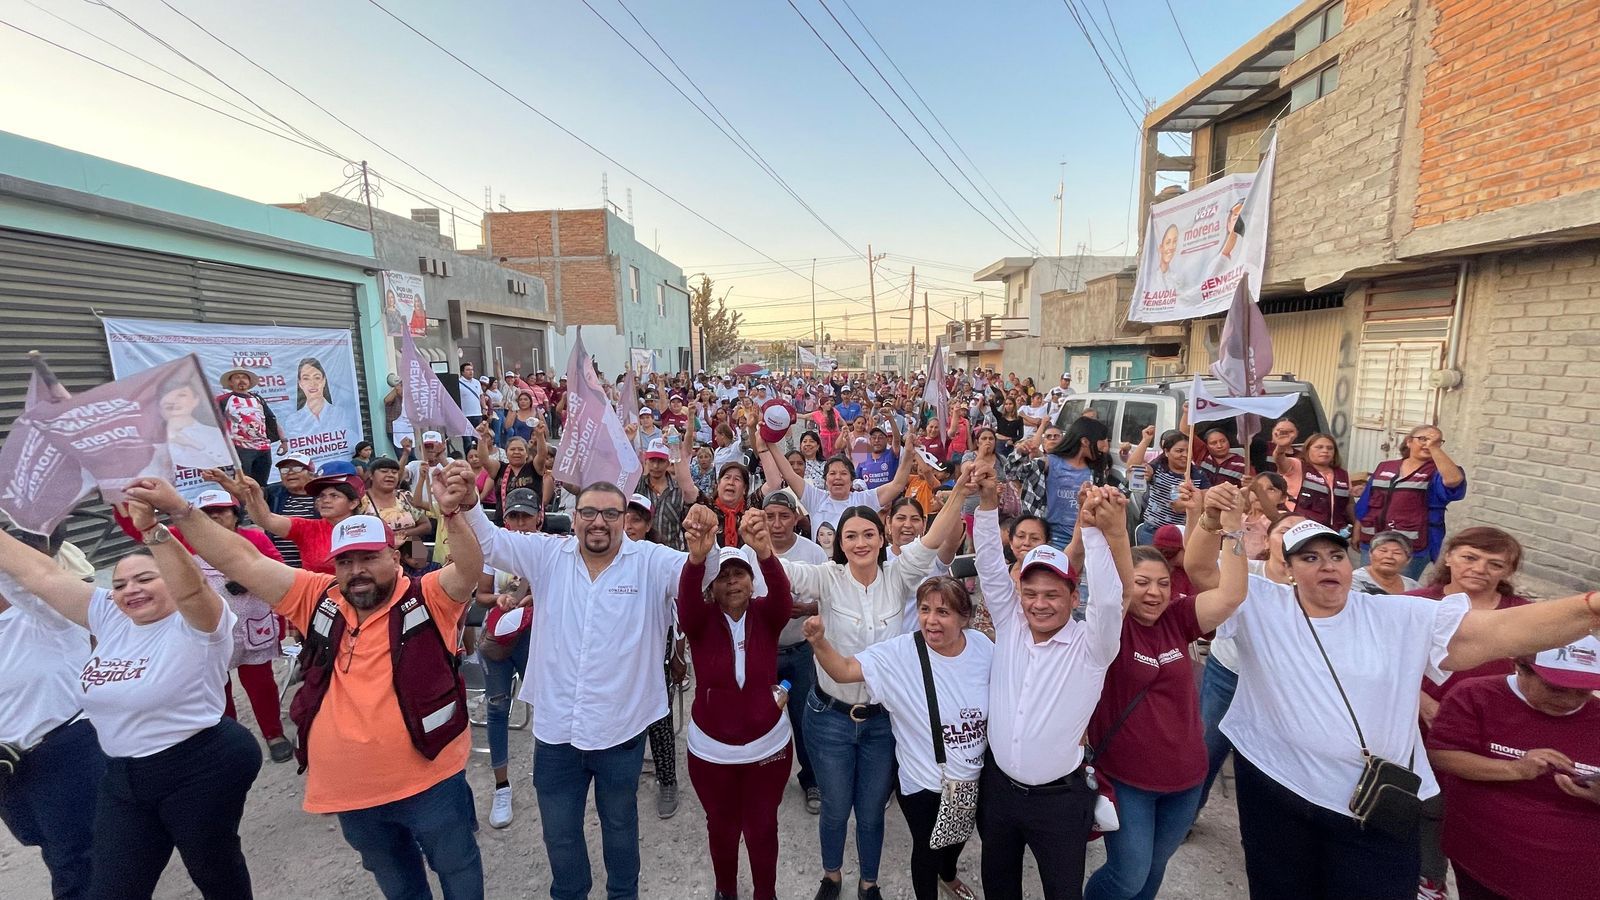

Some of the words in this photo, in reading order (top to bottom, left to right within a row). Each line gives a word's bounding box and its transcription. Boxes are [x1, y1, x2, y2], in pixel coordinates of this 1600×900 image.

[1184, 221, 1220, 242] morena
[233, 357, 271, 367] VOTA
[290, 430, 347, 449] BENNELLY
